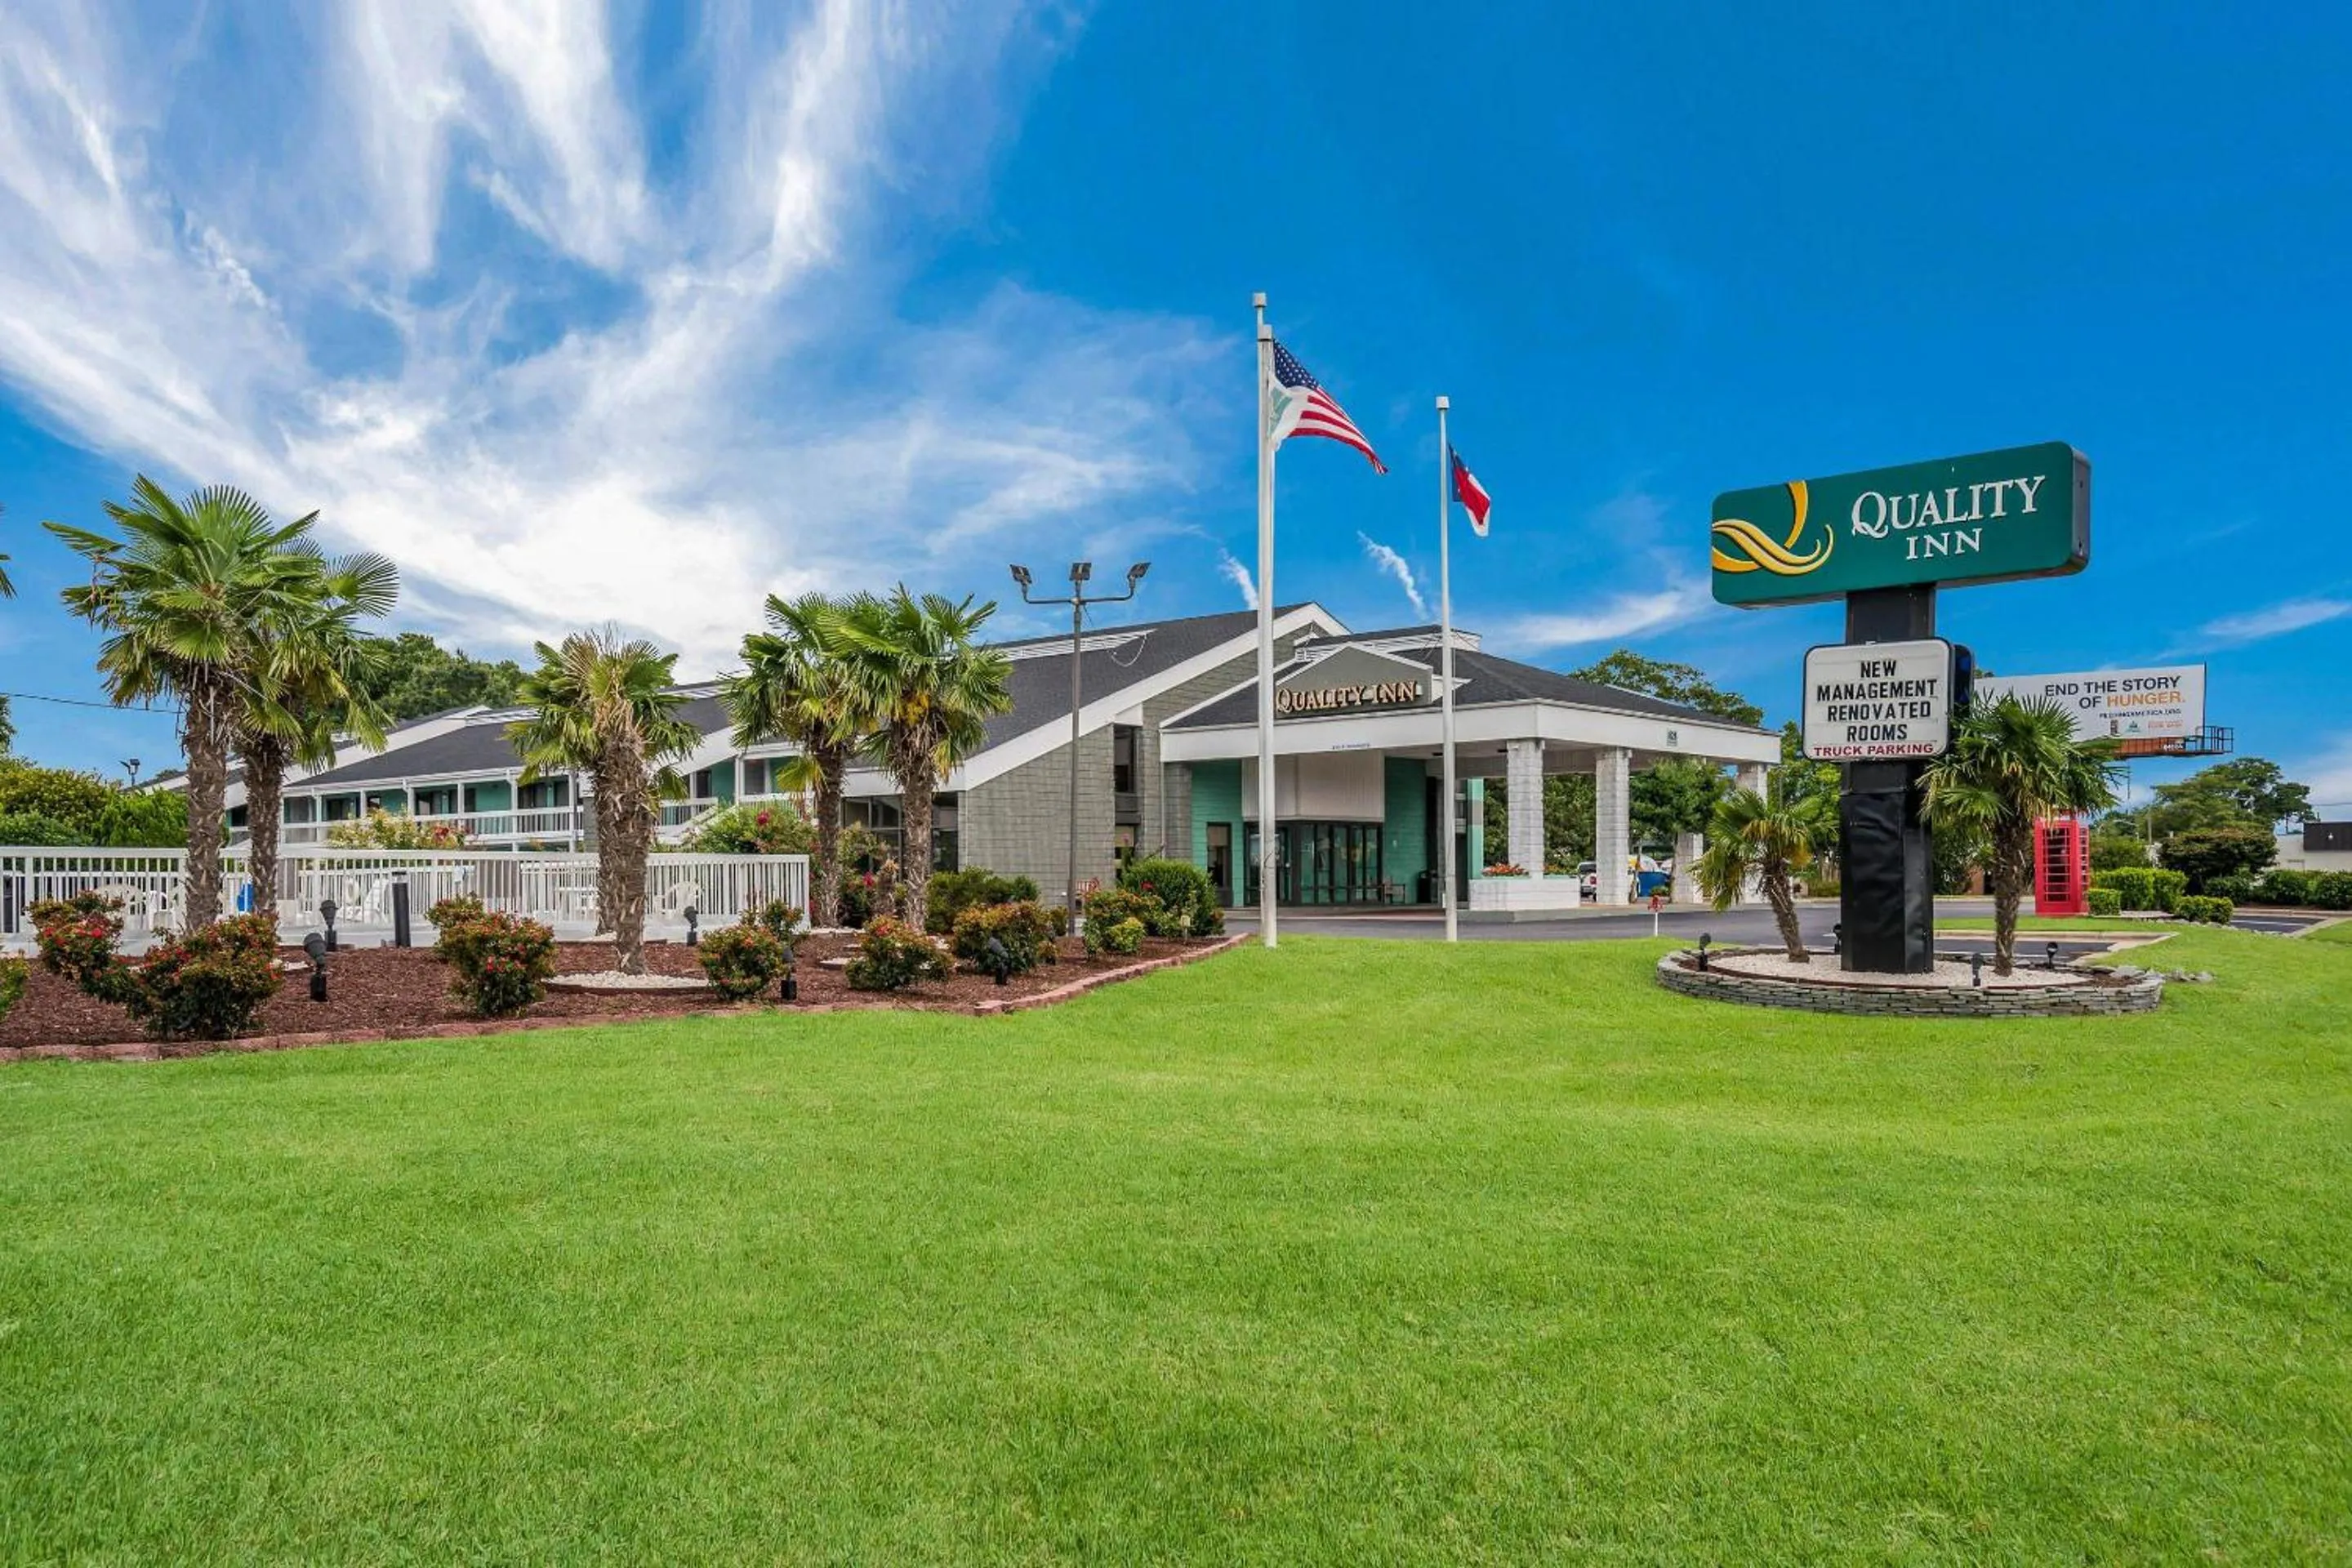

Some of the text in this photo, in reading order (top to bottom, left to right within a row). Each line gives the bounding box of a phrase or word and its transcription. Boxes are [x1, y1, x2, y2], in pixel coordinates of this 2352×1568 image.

[1851, 475, 2046, 539] QUALITY
[1906, 528, 1983, 560] INN
[1860, 660, 1897, 679] NEW
[1276, 679, 1417, 714] QUALITY INN
[1817, 679, 1938, 702] MANAGEMENT
[2044, 675, 2182, 697] END THE STORY
[2079, 691, 2186, 709] OF HUNGER.
[1828, 701, 1931, 722] RENOVATED
[1847, 724, 1908, 742] ROOMS
[1814, 743, 1934, 757] TRUCK PARKING
